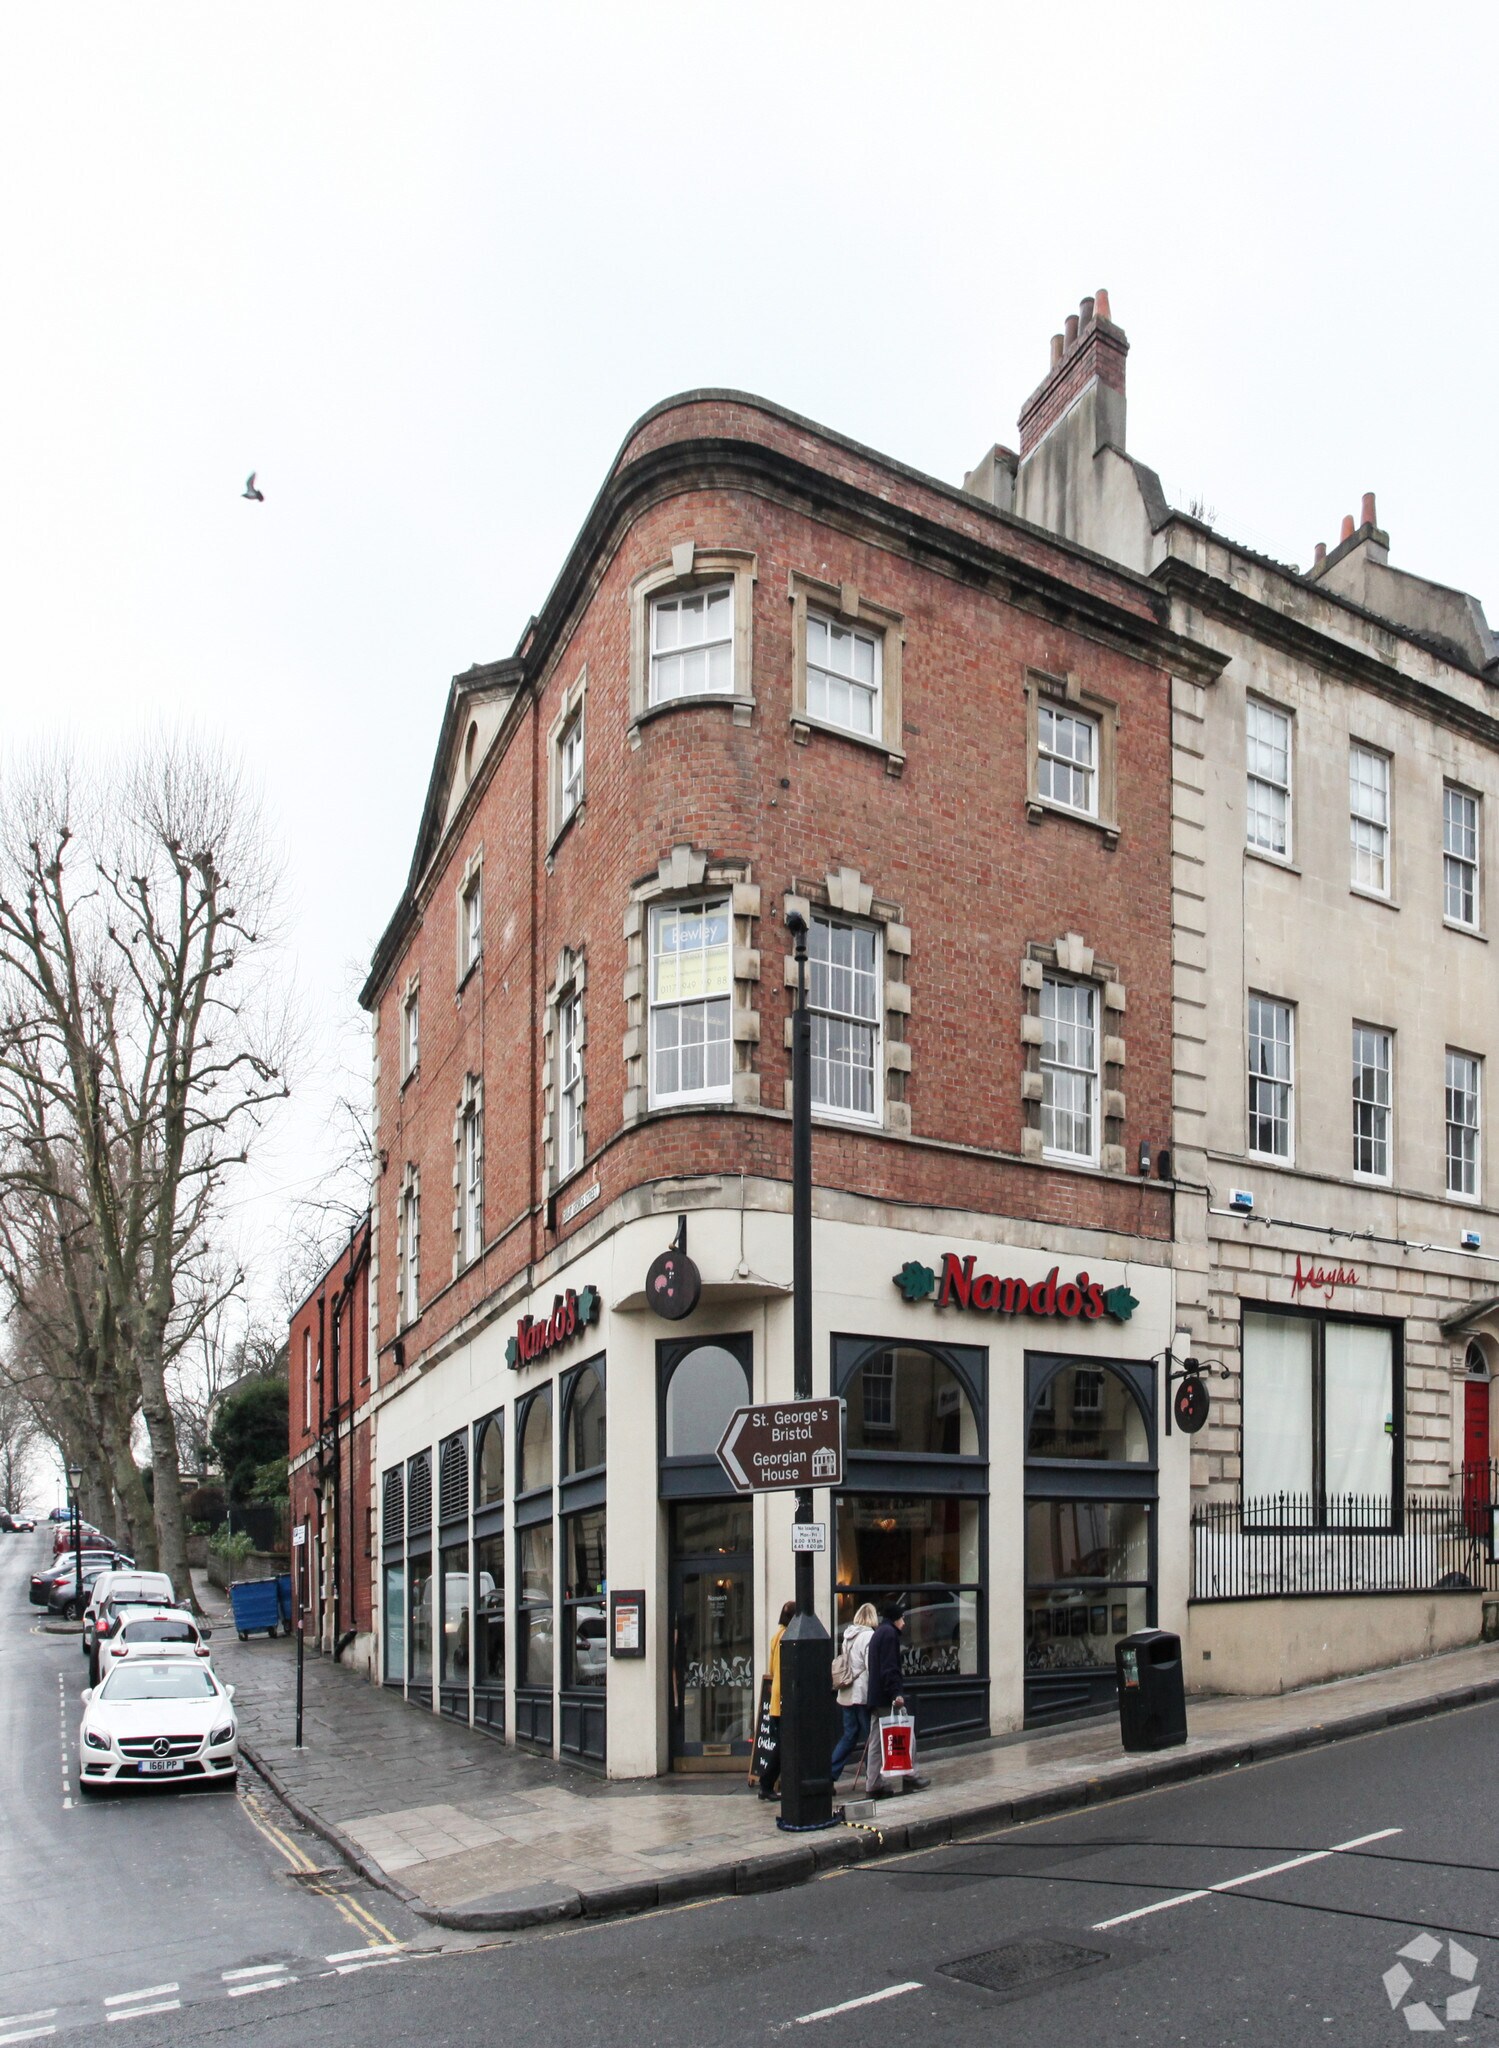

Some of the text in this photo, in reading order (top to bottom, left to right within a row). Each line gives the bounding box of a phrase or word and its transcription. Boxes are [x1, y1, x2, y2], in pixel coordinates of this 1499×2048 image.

[672, 922, 718, 943] Bewley
[934, 1252, 1105, 1319] Nando's
[1291, 1254, 1360, 1300] Mayaa
[515, 1288, 576, 1368] Nando's
[753, 1409, 828, 1427] St. George's
[772, 1426, 812, 1442] Bristol
[753, 1451, 807, 1467] Georgian
[762, 1468, 800, 1482] House
[149, 1760, 177, 1770] 1661 PP
